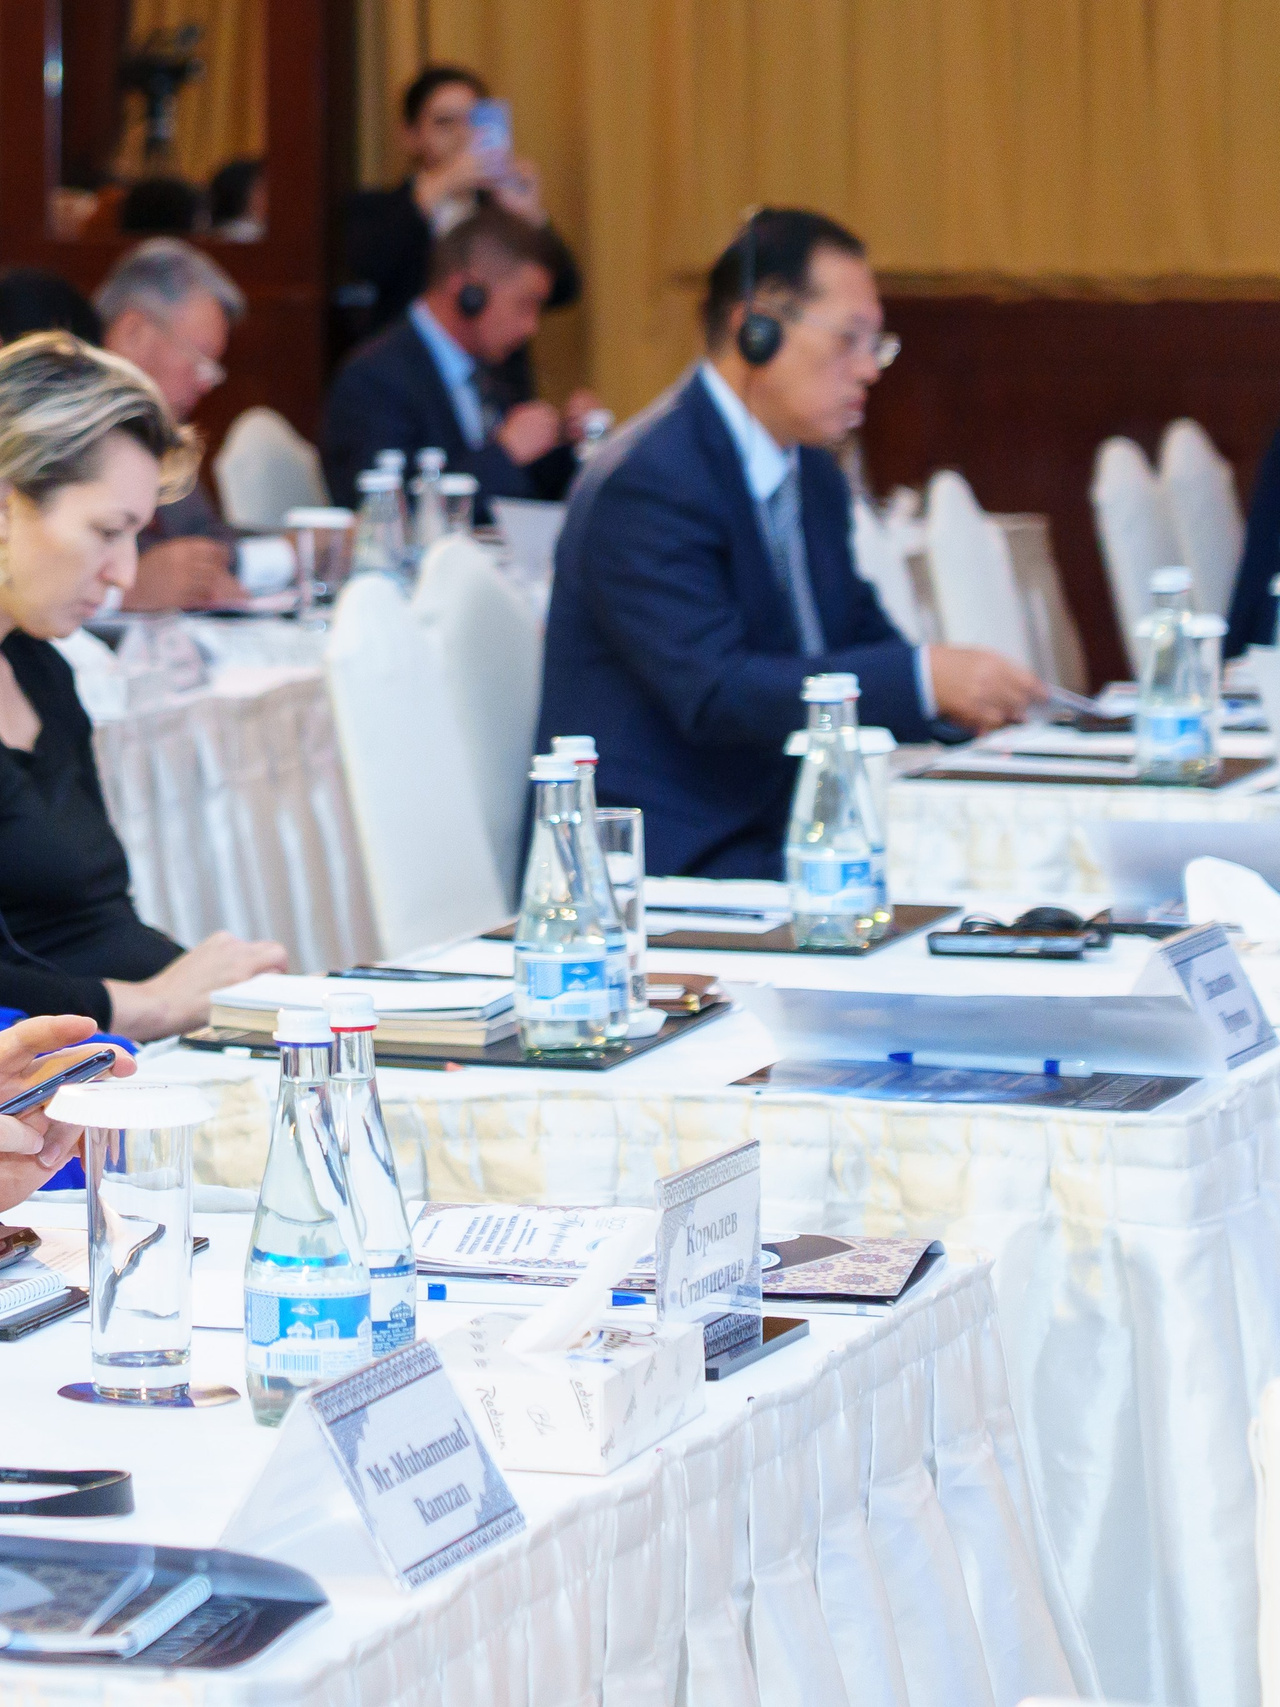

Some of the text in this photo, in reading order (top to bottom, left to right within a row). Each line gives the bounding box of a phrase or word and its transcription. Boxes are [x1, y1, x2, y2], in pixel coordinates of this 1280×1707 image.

[686, 1211, 738, 1257] Королев
[679, 1258, 745, 1309] Станислав
[475, 1385, 507, 1450] Radisson
[413, 1482, 473, 1526] Ramzan
